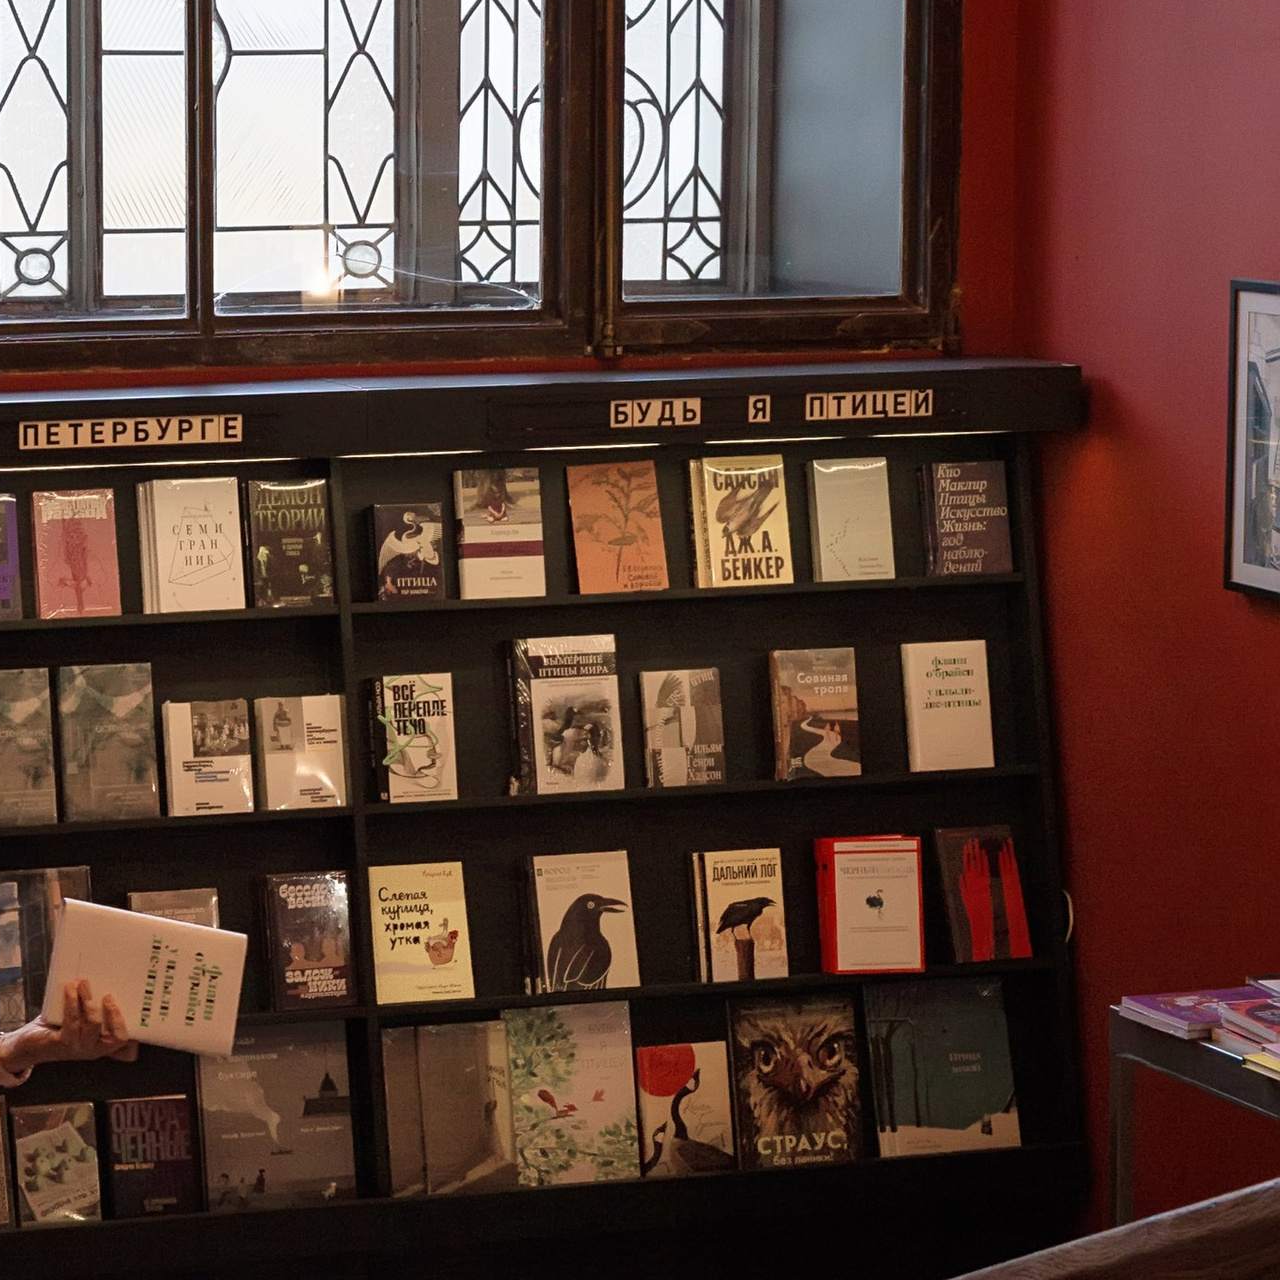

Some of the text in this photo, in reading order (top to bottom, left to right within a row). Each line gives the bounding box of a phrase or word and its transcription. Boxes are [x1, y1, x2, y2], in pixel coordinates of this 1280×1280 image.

[614, 391, 931, 424] БУДЬ Я ПТИЦЕЙ
[22, 417, 240, 446] ПЕТЕРБУРГЕ
[938, 479, 987, 492] Маклир
[939, 492, 986, 506] Птицы
[255, 508, 325, 531] ТЕОРИИ
[940, 505, 1007, 520] Искусство
[172, 522, 222, 535] СЕМИ
[940, 519, 987, 533] Жизнь:
[179, 538, 218, 550] ГРАН
[942, 533, 965, 546] год
[184, 554, 215, 566] НИК
[721, 557, 784, 581] БЕЙКЕР
[397, 577, 437, 588] ПТИЦА
[543, 654, 604, 666] ВЫМЕРШИЕ
[538, 665, 609, 678] ПТИЦЫ МИРА
[797, 672, 848, 684] Совиная
[392, 681, 415, 702] ВСЁ
[813, 684, 849, 696] тропа
[394, 700, 447, 719] ПЕРЕПЛЕ
[687, 755, 715, 769] Генри
[712, 861, 758, 882] ДАЛЬНИЙ
[760, 863, 777, 878] ЛОГ
[378, 886, 428, 902] Слепая
[381, 901, 433, 919] курица,
[384, 920, 429, 935] хромая
[390, 934, 422, 950] утка
[757, 1131, 848, 1156] СТРАУС,
